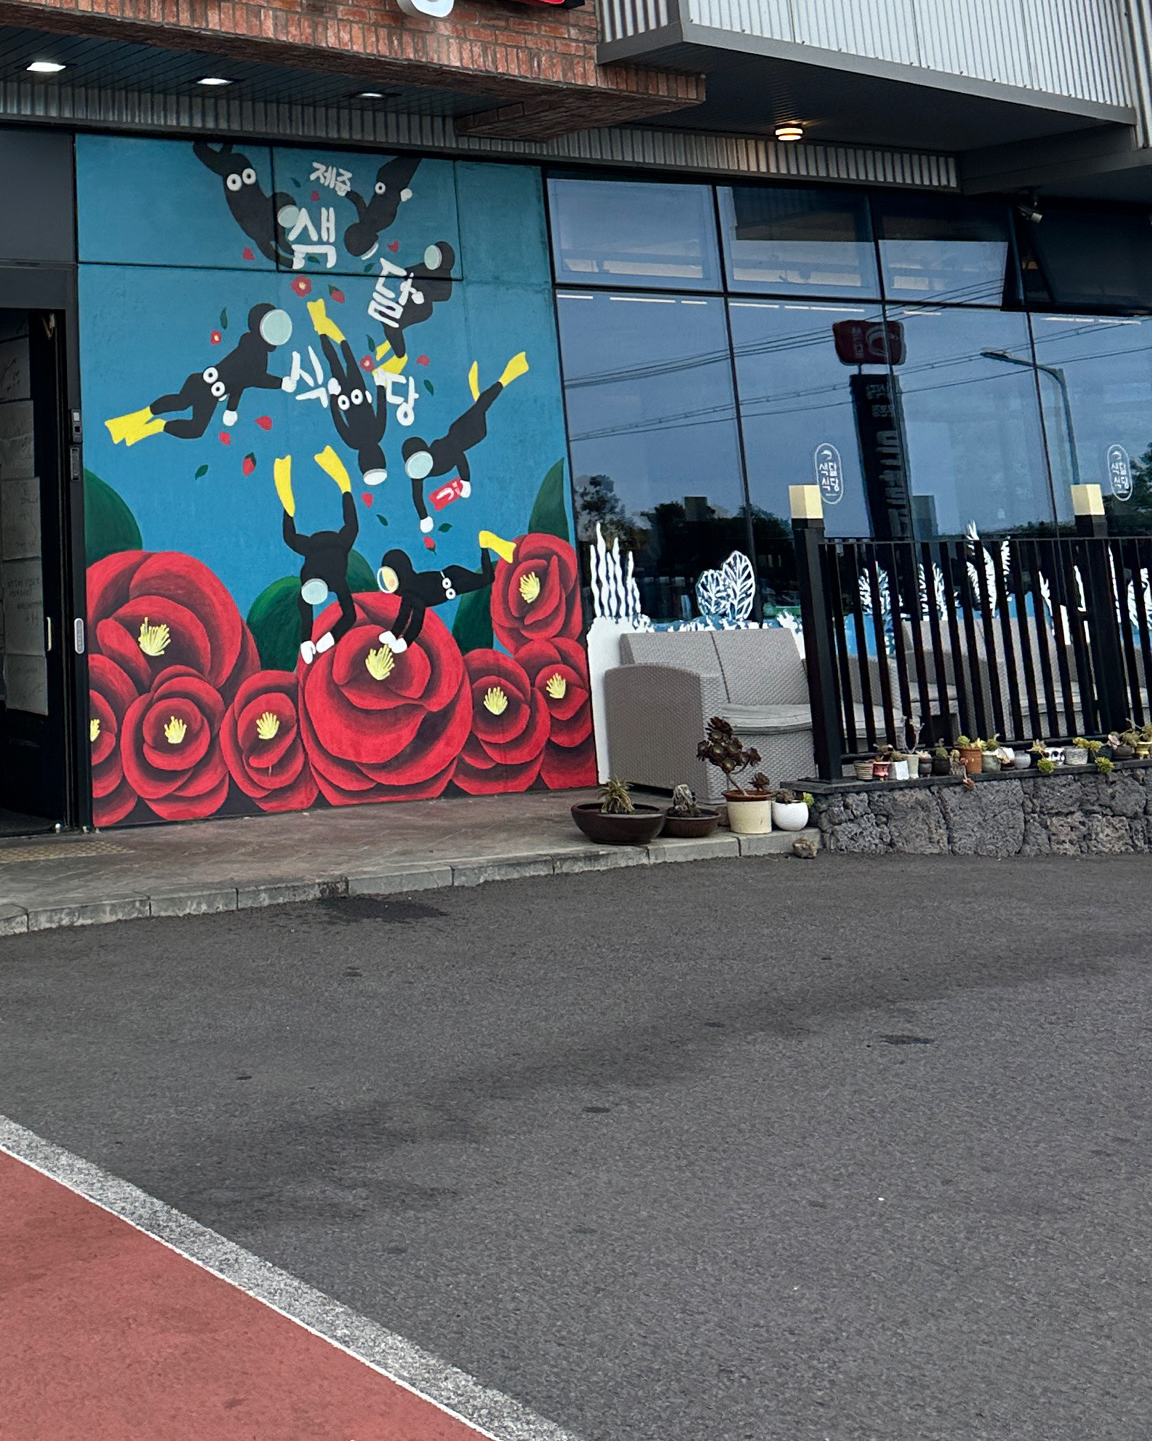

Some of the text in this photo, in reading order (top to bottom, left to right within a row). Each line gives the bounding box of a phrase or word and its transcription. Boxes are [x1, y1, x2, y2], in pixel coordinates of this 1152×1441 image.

[288, 207, 337, 270] 색
[367, 257, 418, 328] 달
[293, 345, 330, 409] 식
[385, 372, 420, 427] 당
[819, 462, 838, 477] 색달
[821, 477, 840, 492] 식당
[1111, 462, 1127, 476] 색달
[1114, 476, 1130, 490] 식당
